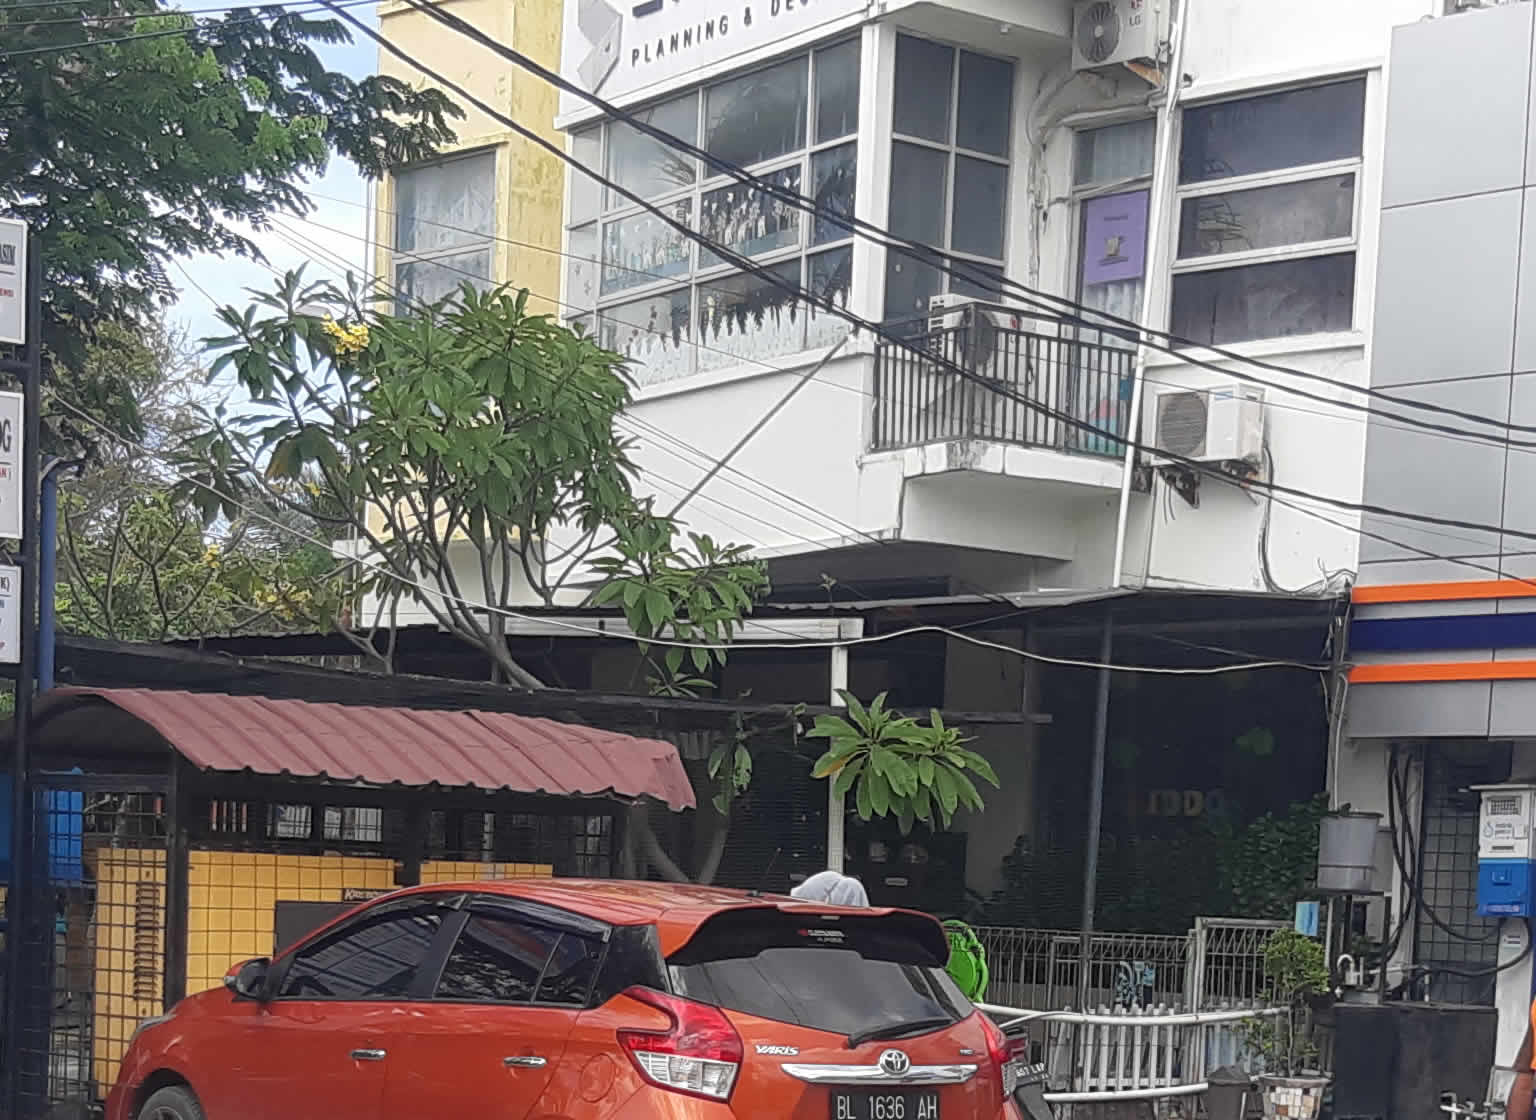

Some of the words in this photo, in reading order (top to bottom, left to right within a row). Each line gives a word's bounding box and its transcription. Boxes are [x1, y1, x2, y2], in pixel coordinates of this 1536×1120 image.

[631, 15, 729, 68] PLANNING
[743, 6, 752, 26] &
[754, 1044, 801, 1056] YARIS
[837, 1096, 857, 1120] BL
[868, 1096, 905, 1120] 1636
[917, 1095, 938, 1120] AH
